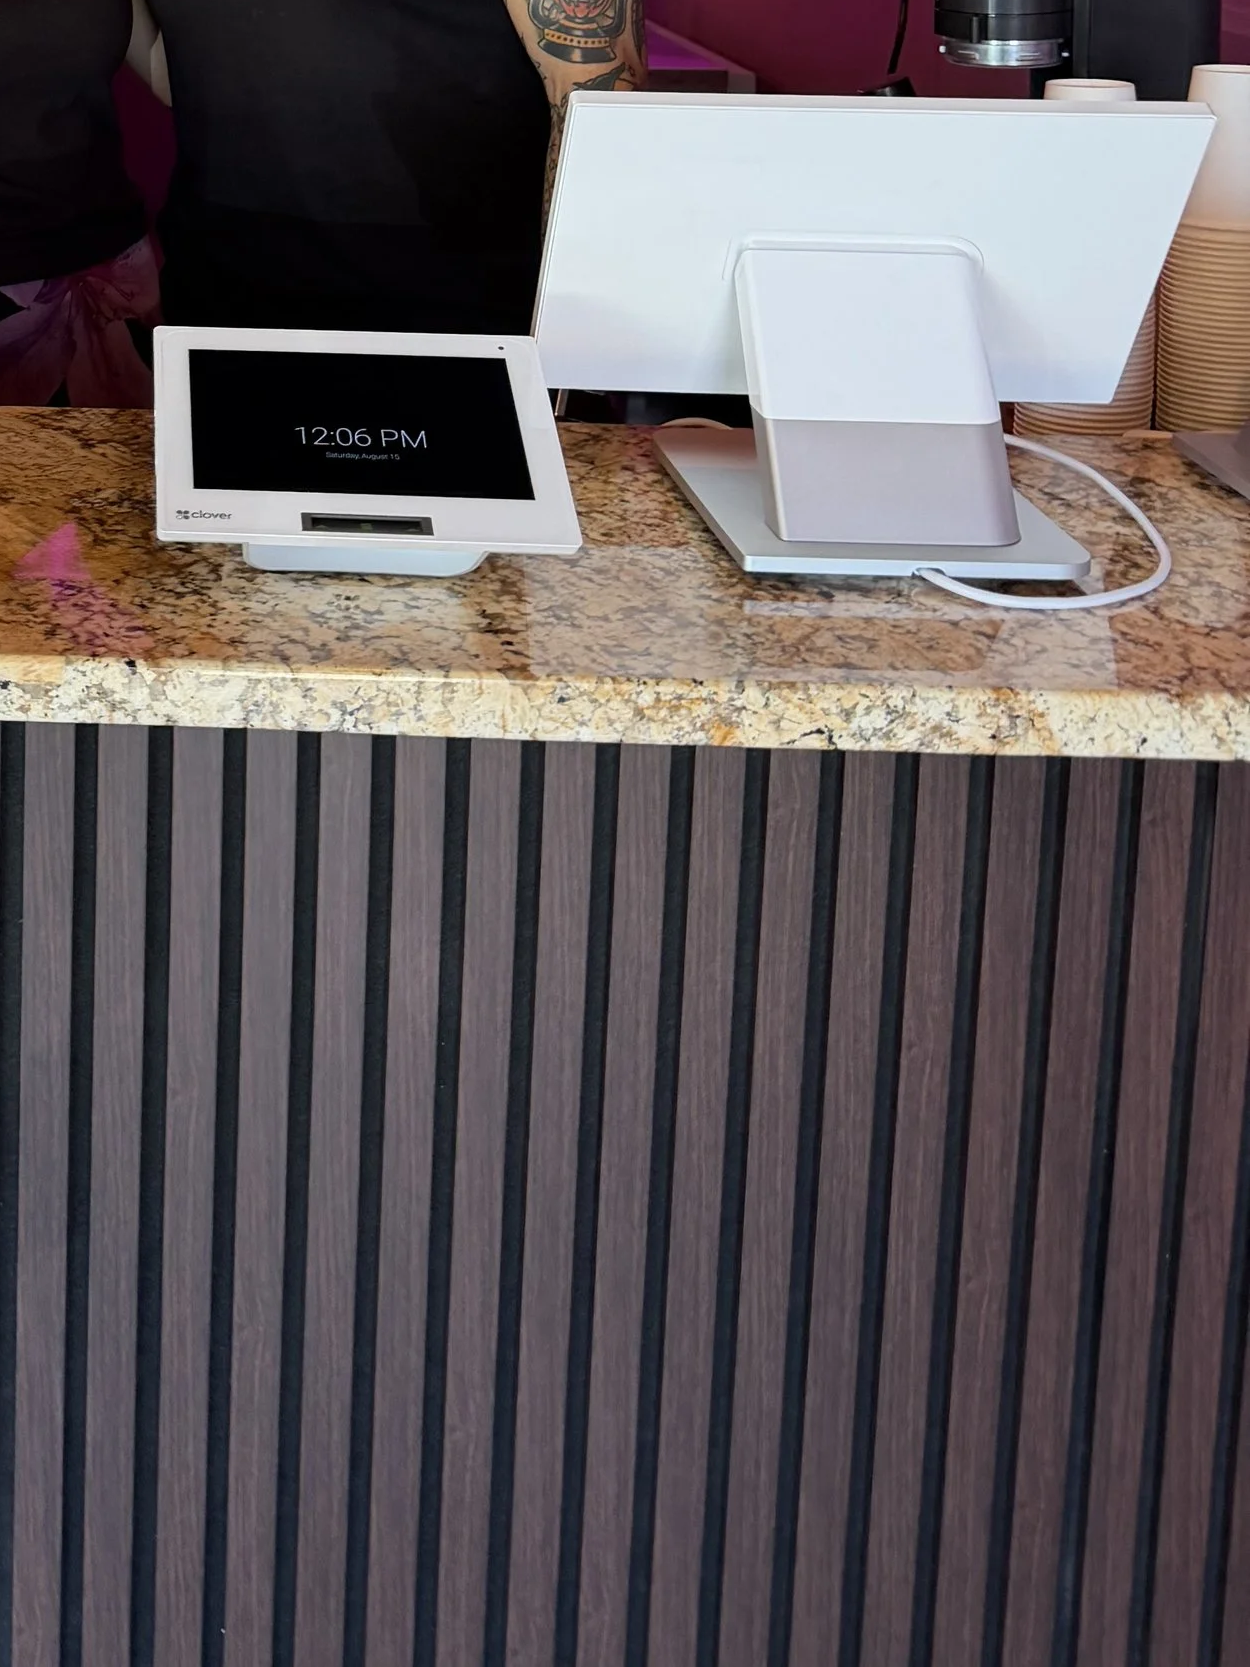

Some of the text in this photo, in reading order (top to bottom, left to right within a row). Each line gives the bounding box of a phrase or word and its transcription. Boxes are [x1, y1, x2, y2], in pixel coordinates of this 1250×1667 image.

[294, 426, 427, 448] 12:06 PM
[191, 510, 233, 520] clover
